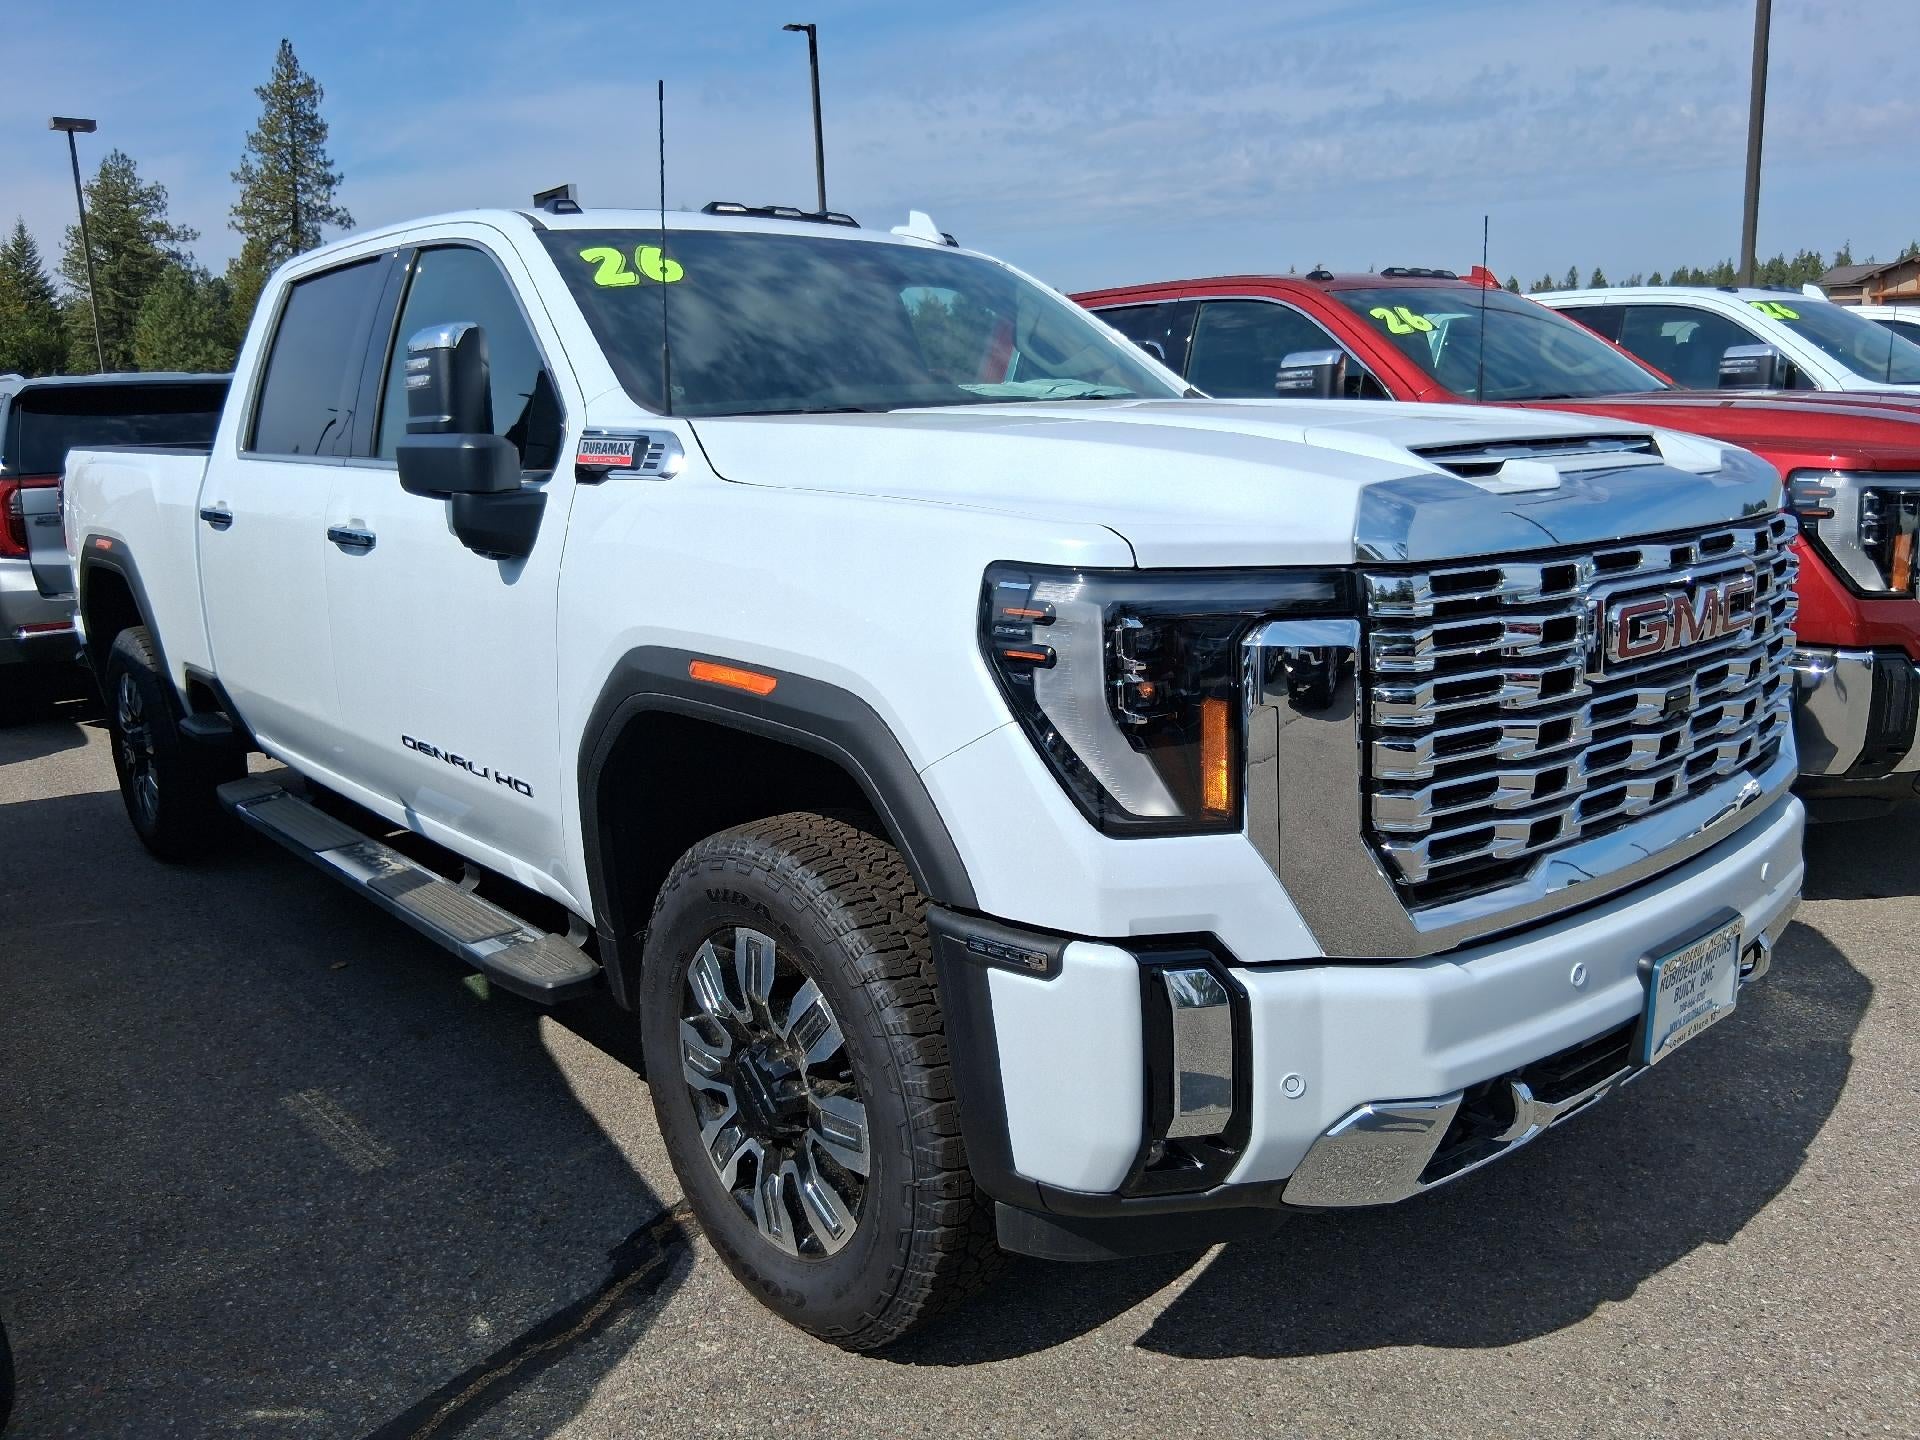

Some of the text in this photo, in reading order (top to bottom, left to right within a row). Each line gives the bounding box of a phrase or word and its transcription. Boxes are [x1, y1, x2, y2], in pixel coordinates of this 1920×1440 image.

[580, 245, 684, 287] 26
[1369, 306, 1433, 334] 26
[583, 441, 631, 455] DURAMAX
[1607, 578, 1754, 661] GMC
[401, 733, 535, 799] DENALI HD
[1704, 938, 1732, 967] MOTORS
[1674, 965, 1715, 1003] BUICK GMC
